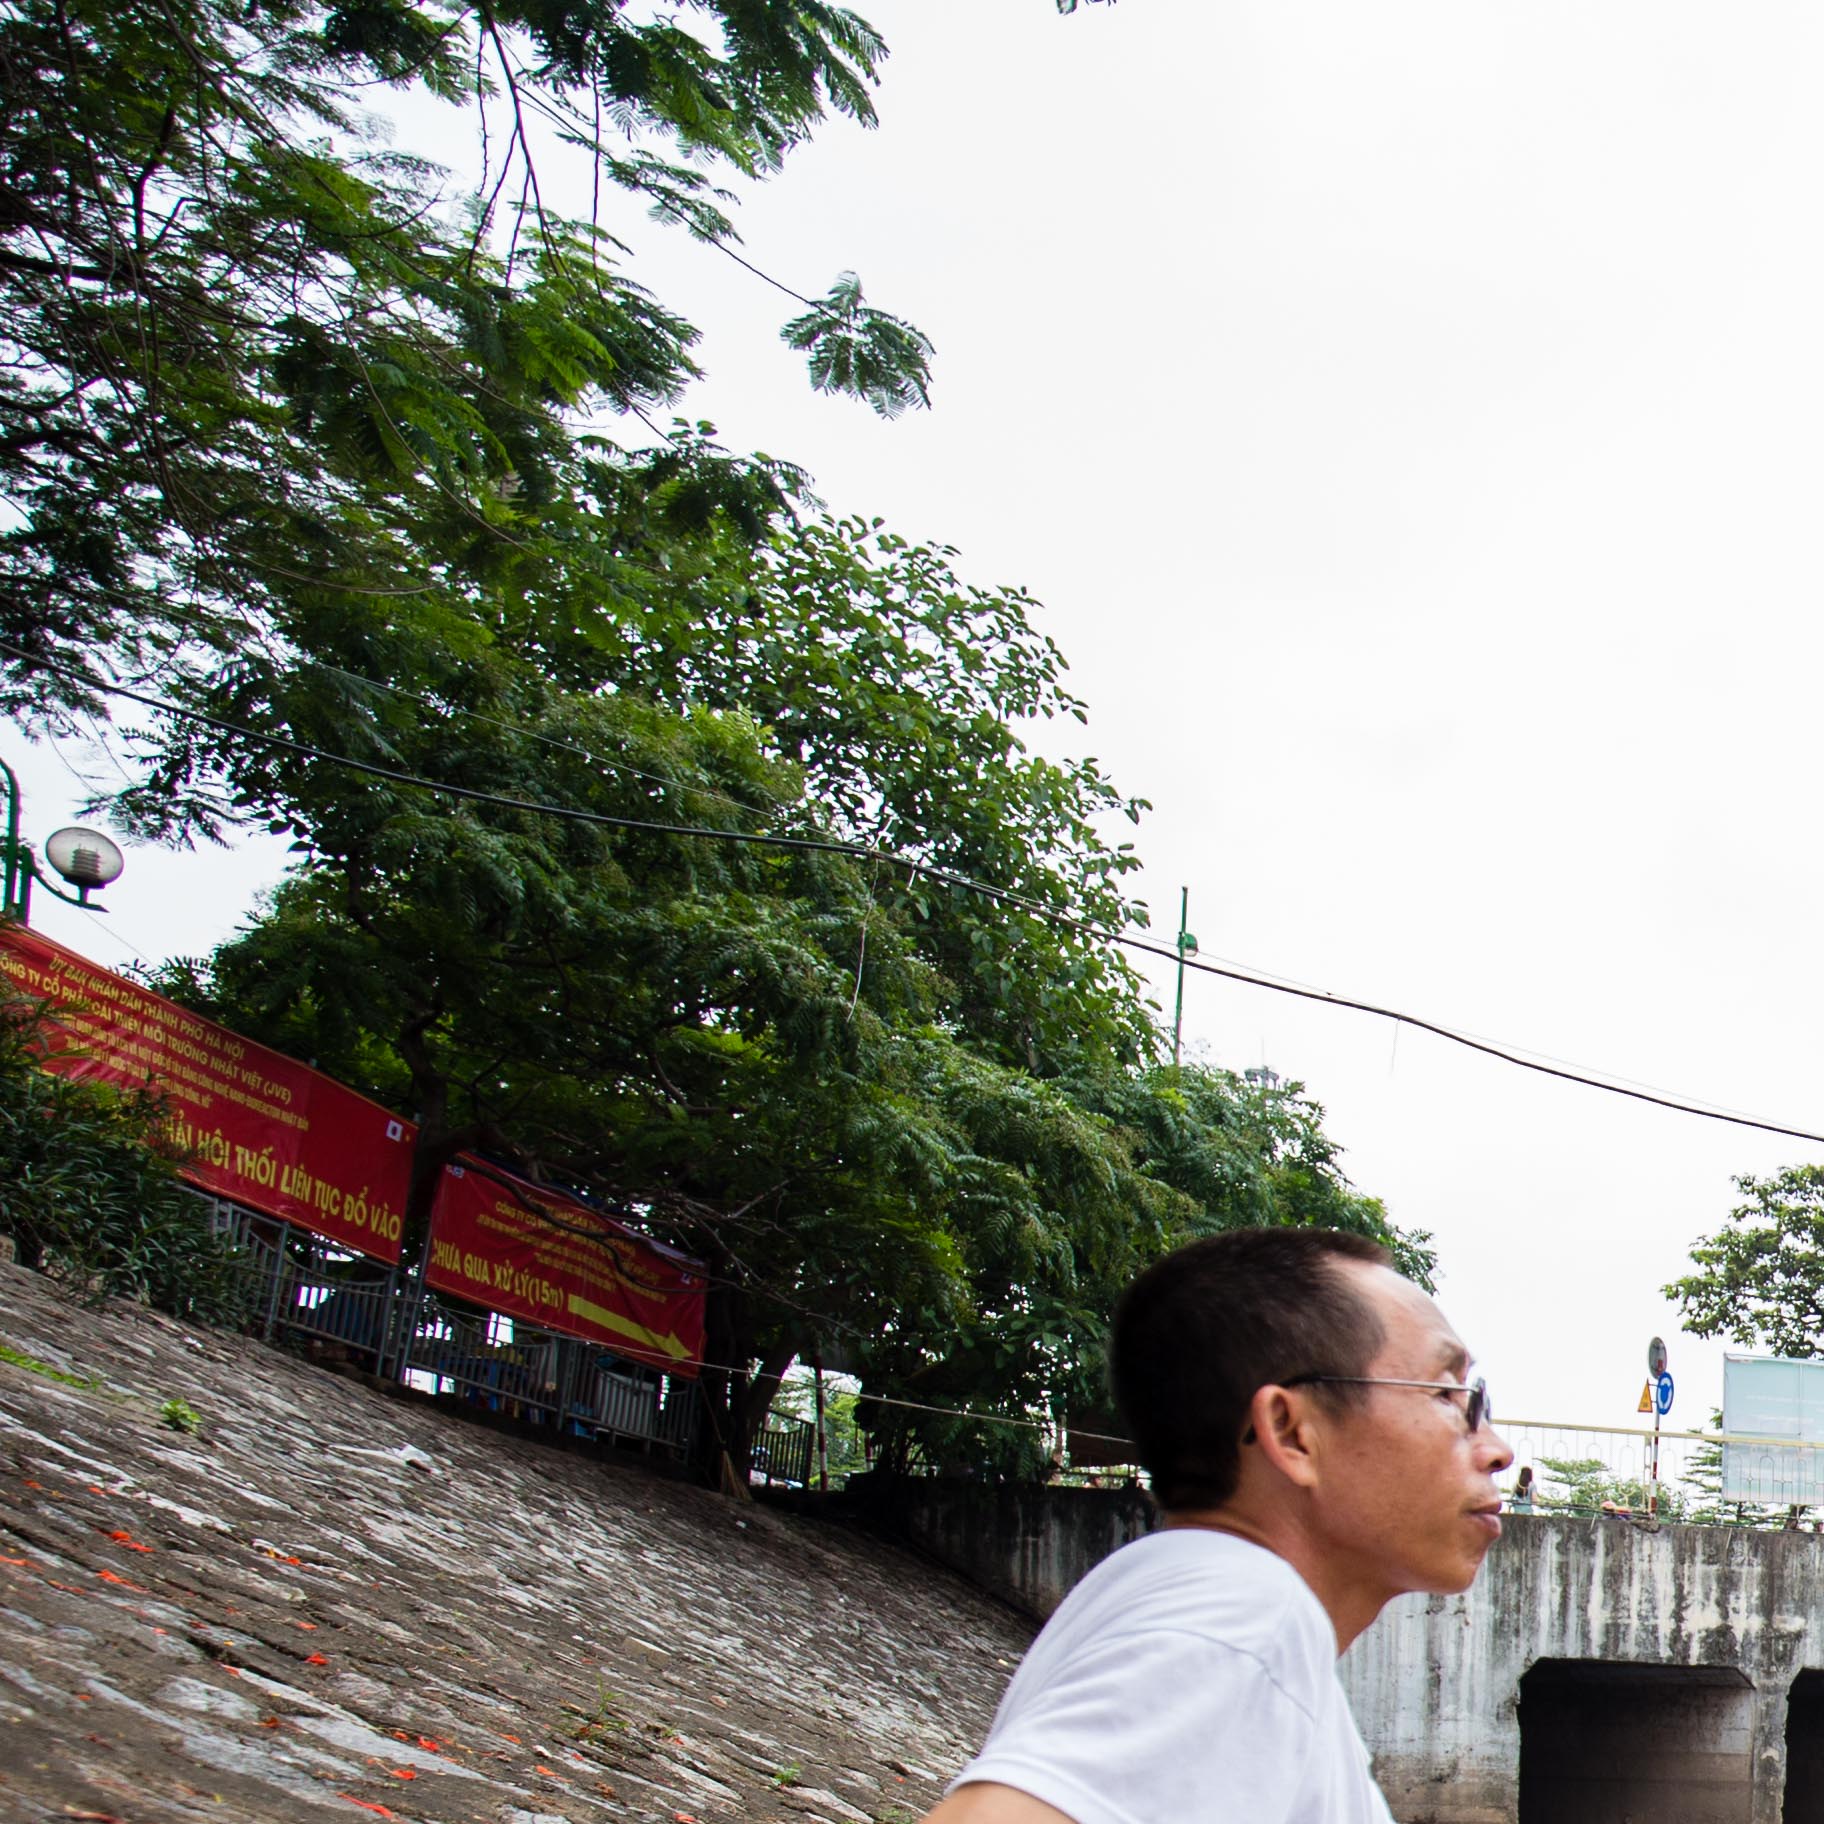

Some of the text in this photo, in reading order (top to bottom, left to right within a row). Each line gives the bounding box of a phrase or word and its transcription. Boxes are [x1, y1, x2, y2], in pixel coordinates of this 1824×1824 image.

[0, 951, 26, 980] ÔNG
[28, 968, 41, 987] TY
[43, 974, 60, 996] CỔ
[143, 1023, 166, 1046] MÔI
[263, 1081, 292, 1105] (JVE)
[144, 1001, 178, 1029] THÀNH
[180, 1020, 205, 1041] PHỐ
[205, 1032, 221, 1050] HÀ
[223, 1041, 246, 1060] NỘI
[197, 1128, 230, 1170] HÔI
[235, 1146, 276, 1189] THỐI
[280, 1164, 311, 1203] LIÊN
[315, 1180, 341, 1219] TỤC
[343, 1186, 368, 1227] ĐỔ
[371, 1203, 401, 1242] VÀO
[463, 1252, 491, 1286] QUA
[493, 1258, 514, 1293] XỬ
